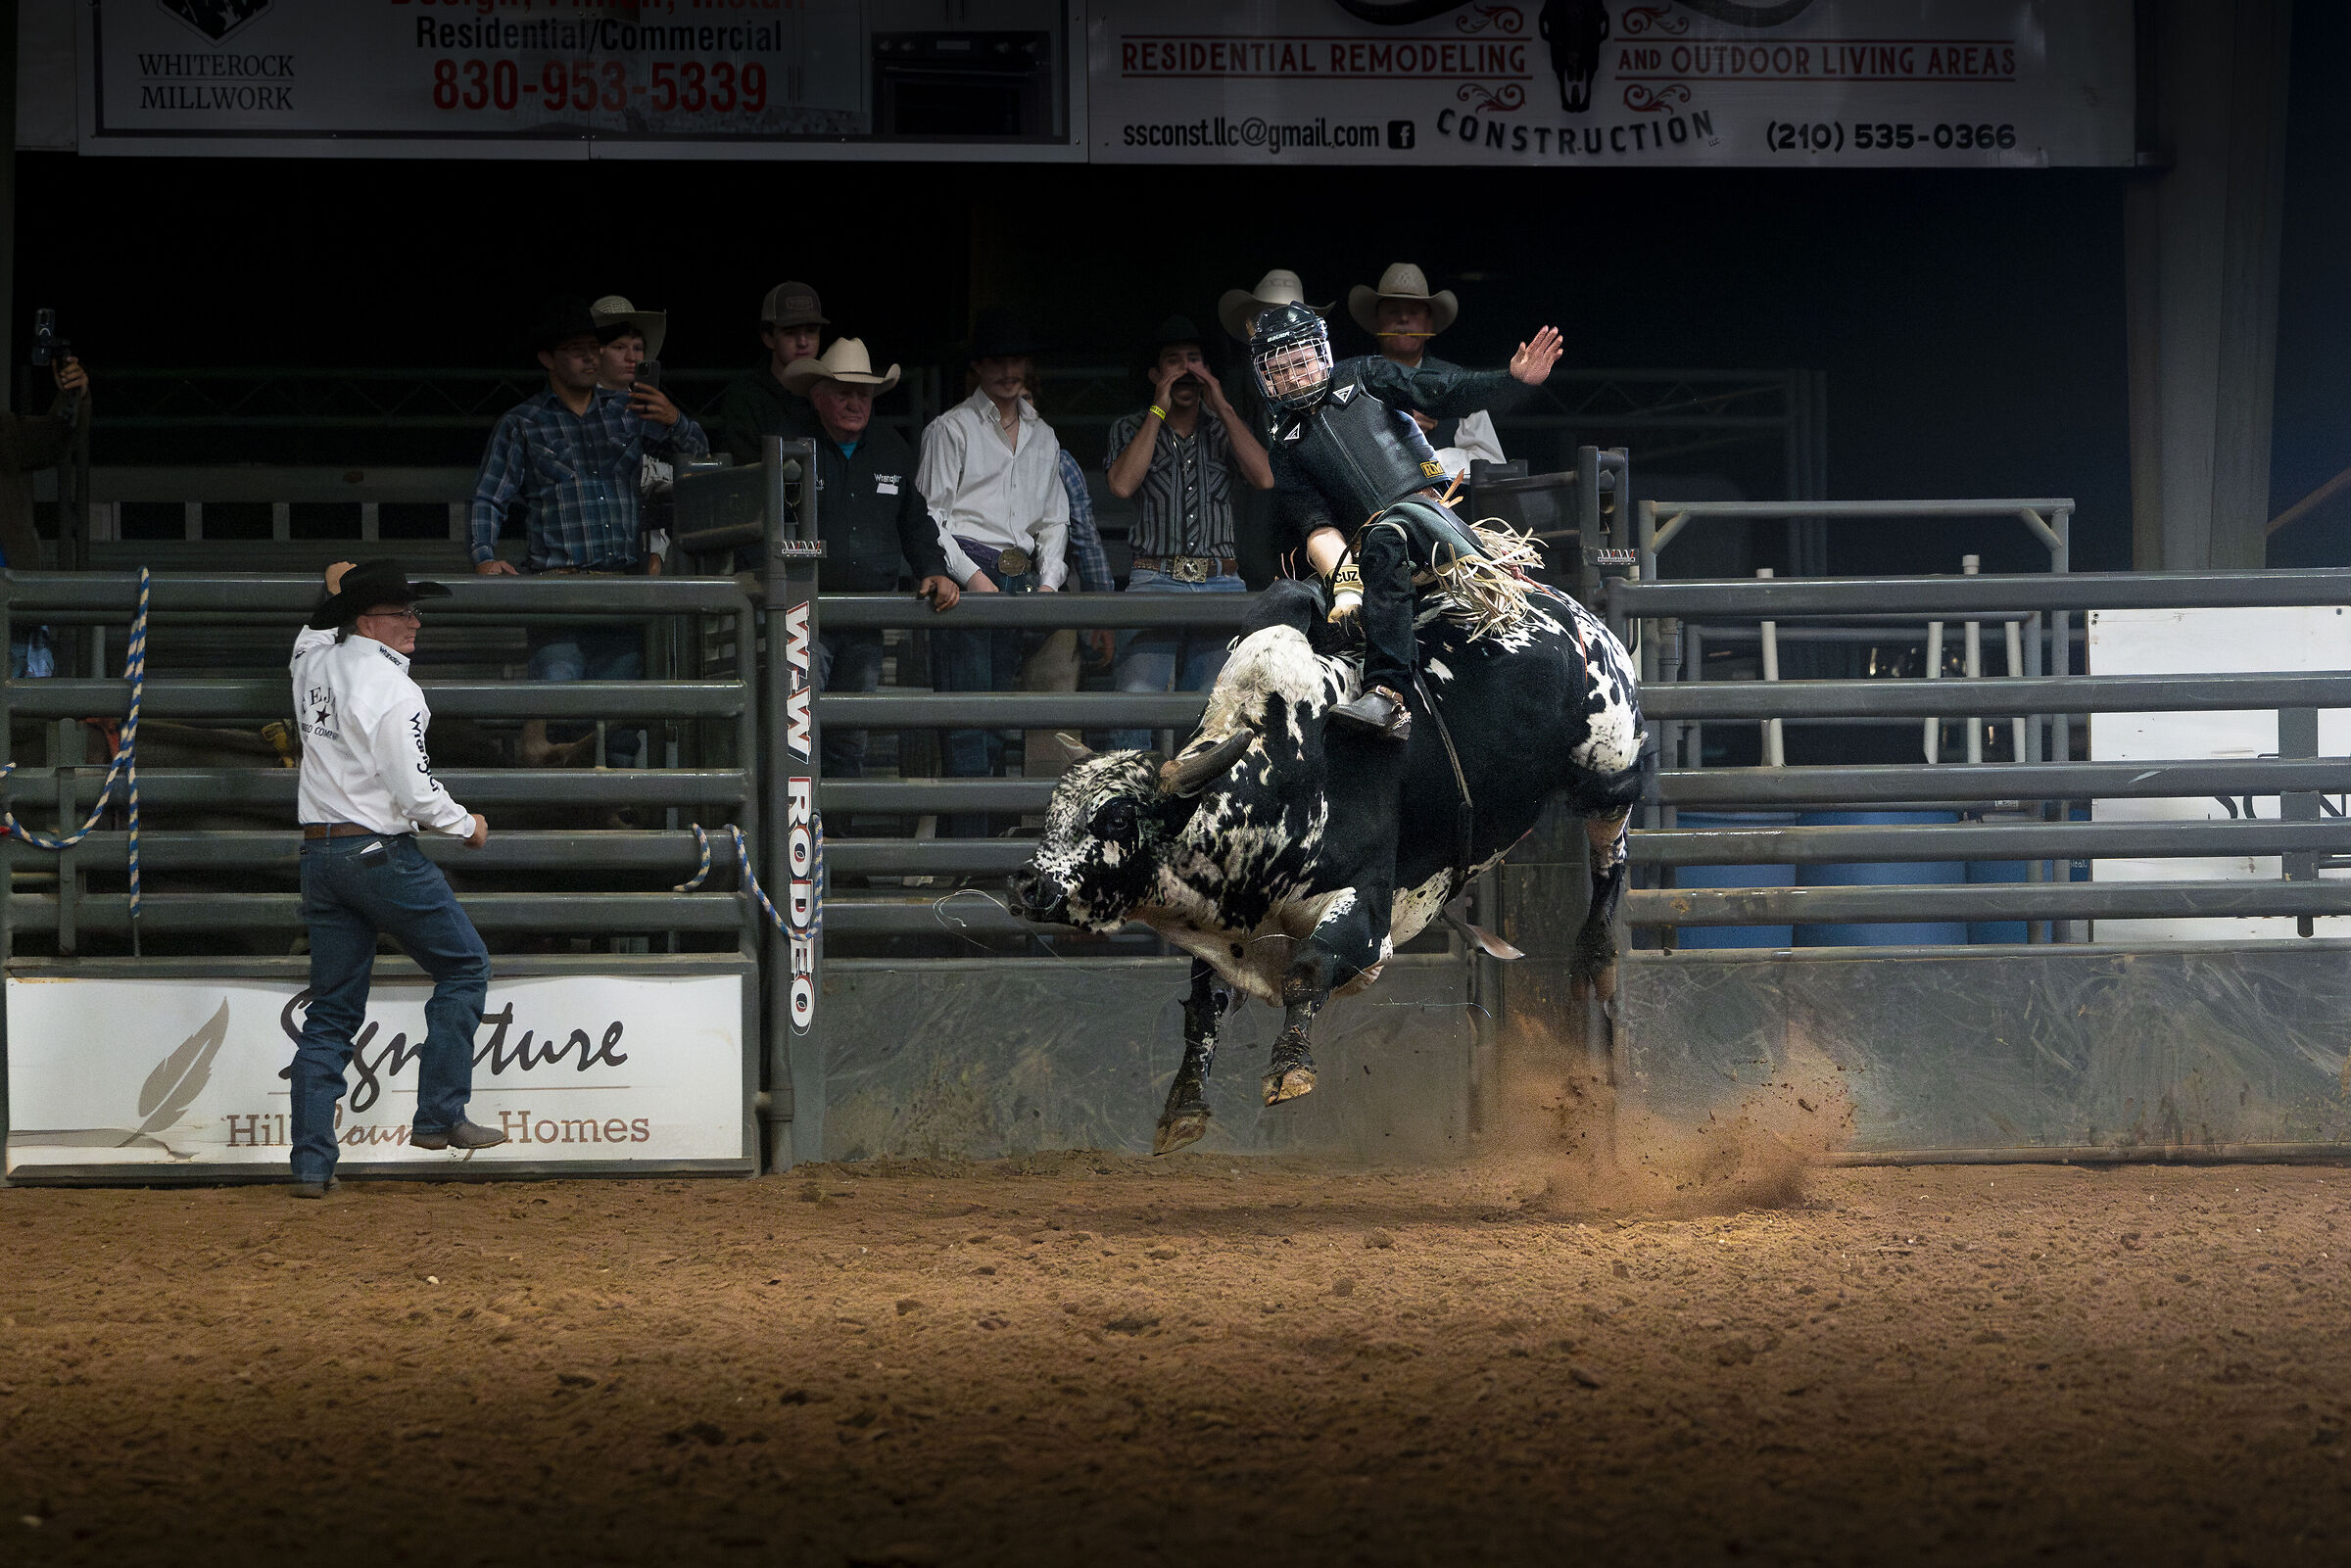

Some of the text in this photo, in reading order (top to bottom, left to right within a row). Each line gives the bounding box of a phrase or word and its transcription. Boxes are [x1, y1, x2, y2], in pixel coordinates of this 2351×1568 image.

[416, 16, 782, 52] Residential/Commercial
[138, 54, 295, 77] WHITEROCK
[1122, 42, 2016, 75] RESIDENTIAL REMODELING AND OUTDOOR LIVING AREAS
[139, 85, 294, 110] MILLWORK
[433, 59, 767, 112] 830-953-5339
[1123, 117, 1380, 154] ssconst.llc@gmail.com
[1437, 109, 1714, 155] CONSTRUCTION
[1767, 120, 2016, 153] (210) 535-0366
[788, 776, 815, 1036] RODEO
[226, 1114, 292, 1147] Hil
[498, 1110, 650, 1144] Homes
